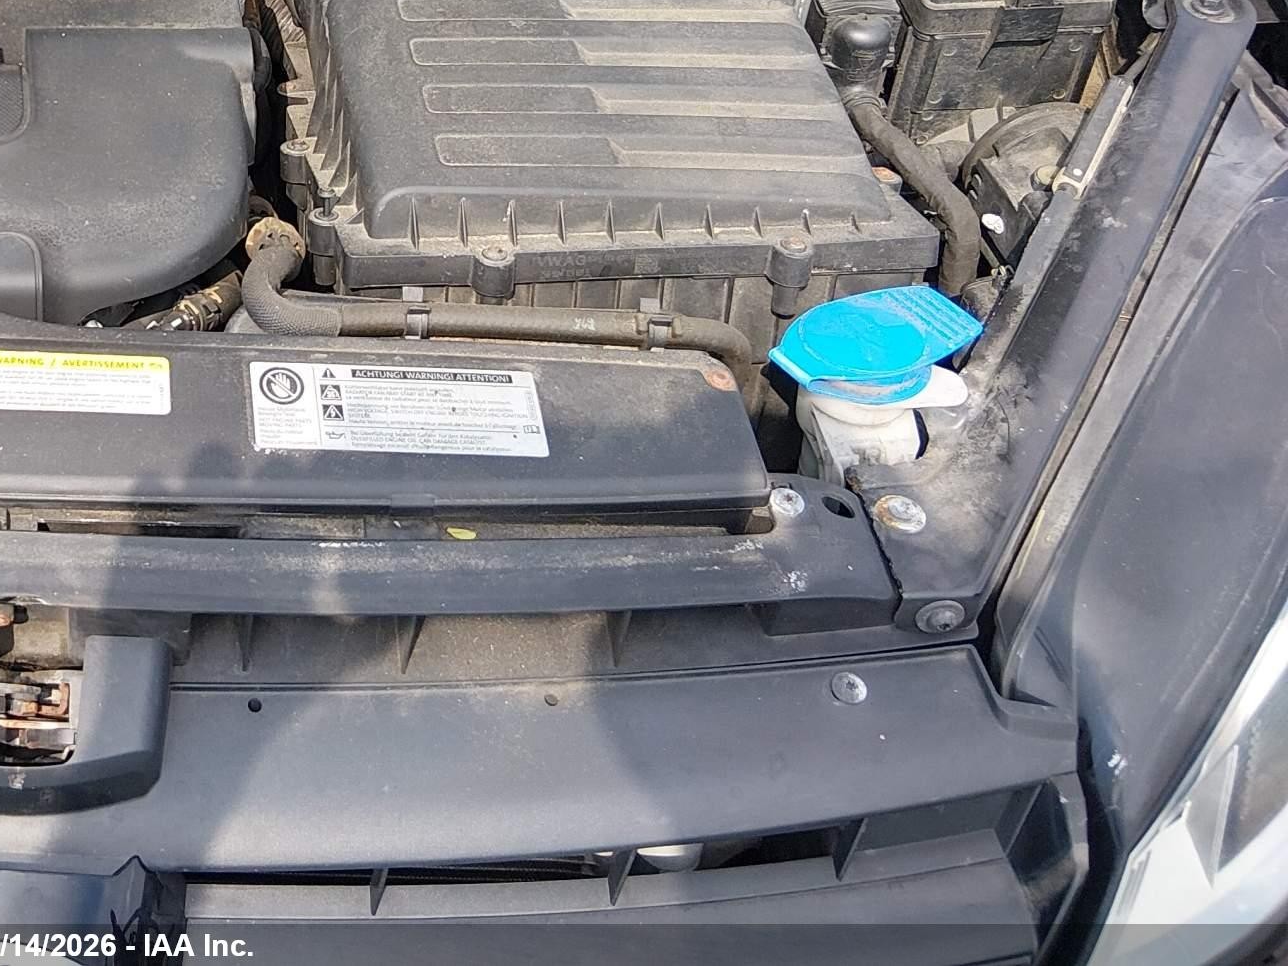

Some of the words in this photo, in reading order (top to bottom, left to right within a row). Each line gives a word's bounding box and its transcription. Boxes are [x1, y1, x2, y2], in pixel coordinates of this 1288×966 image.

[62, 358, 145, 370] AVERTISSEMENT
[354, 370, 403, 379] ACHTUNG!
[405, 371, 454, 381] WARNING!
[455, 373, 509, 383] ATTENTION!
